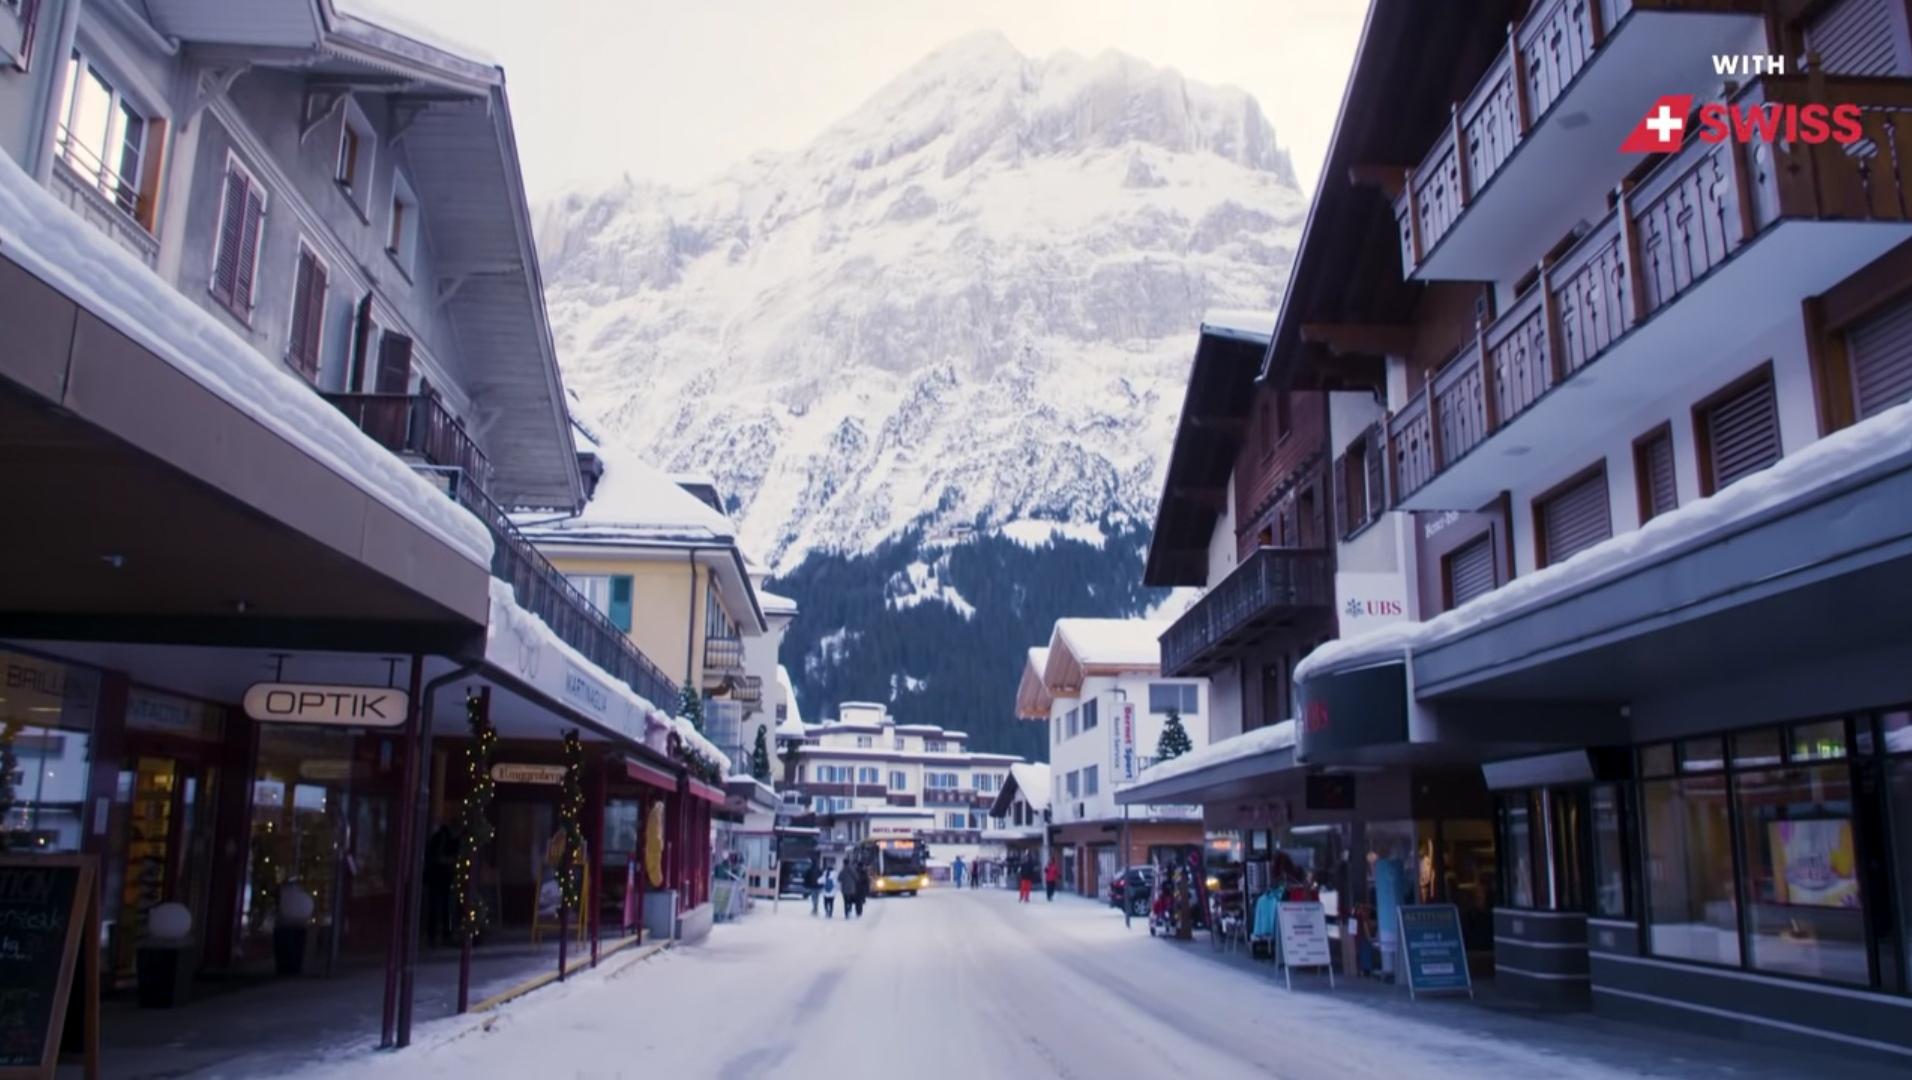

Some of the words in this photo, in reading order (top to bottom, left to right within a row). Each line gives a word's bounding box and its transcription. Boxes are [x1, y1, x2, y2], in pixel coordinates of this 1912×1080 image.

[1366, 600, 1402, 616] UBS
[266, 690, 387, 719] OPTIK
[1124, 747, 1133, 779] Sport
